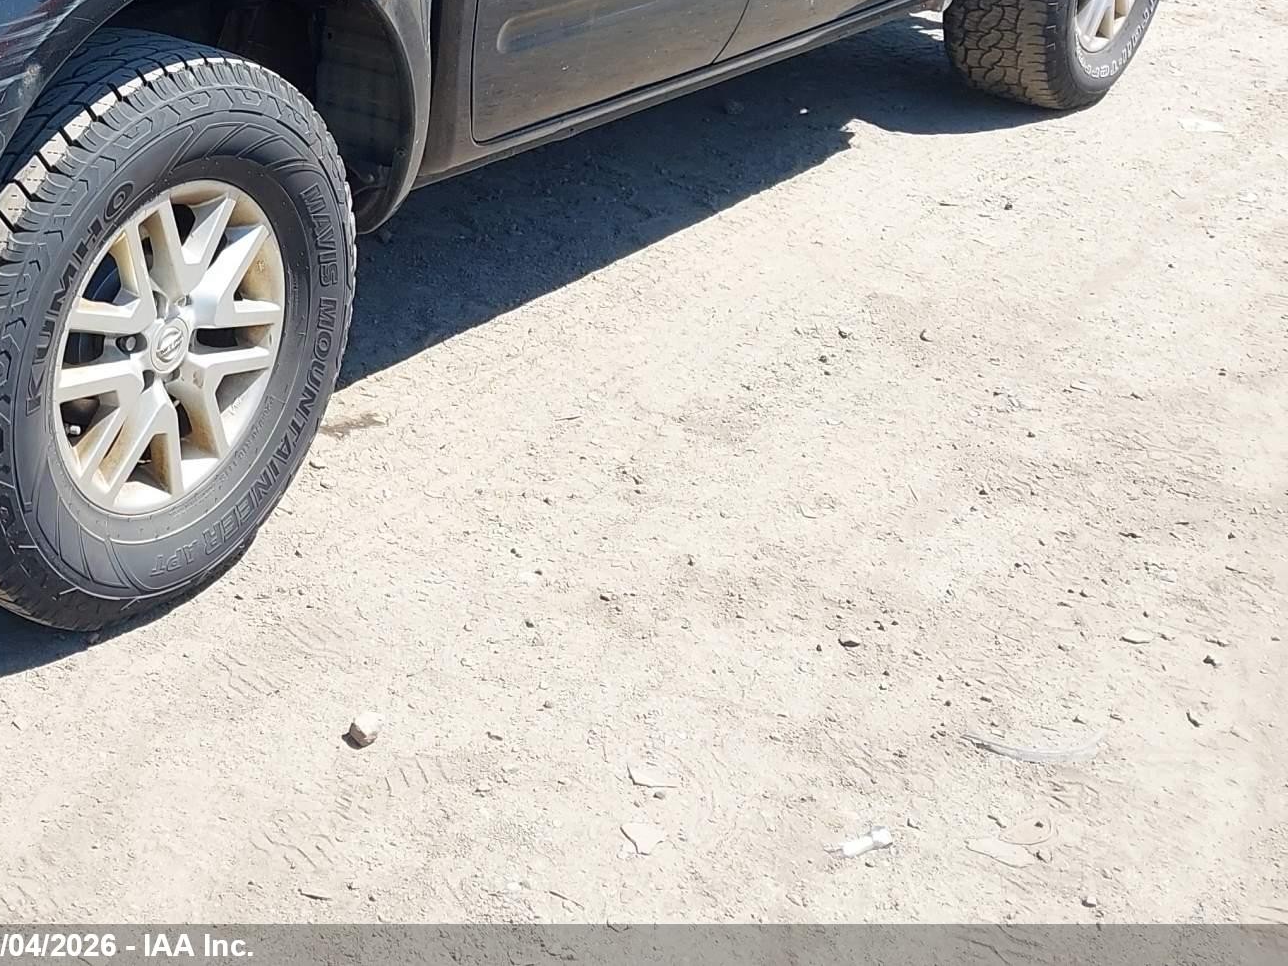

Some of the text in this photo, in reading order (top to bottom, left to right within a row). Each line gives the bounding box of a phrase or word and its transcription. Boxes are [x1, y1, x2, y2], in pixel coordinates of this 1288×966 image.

[25, 181, 134, 416] KUMHO
[300, 183, 339, 288] MAVIS
[202, 297, 337, 556] MOUNTAINEER
[152, 539, 199, 575] APT
